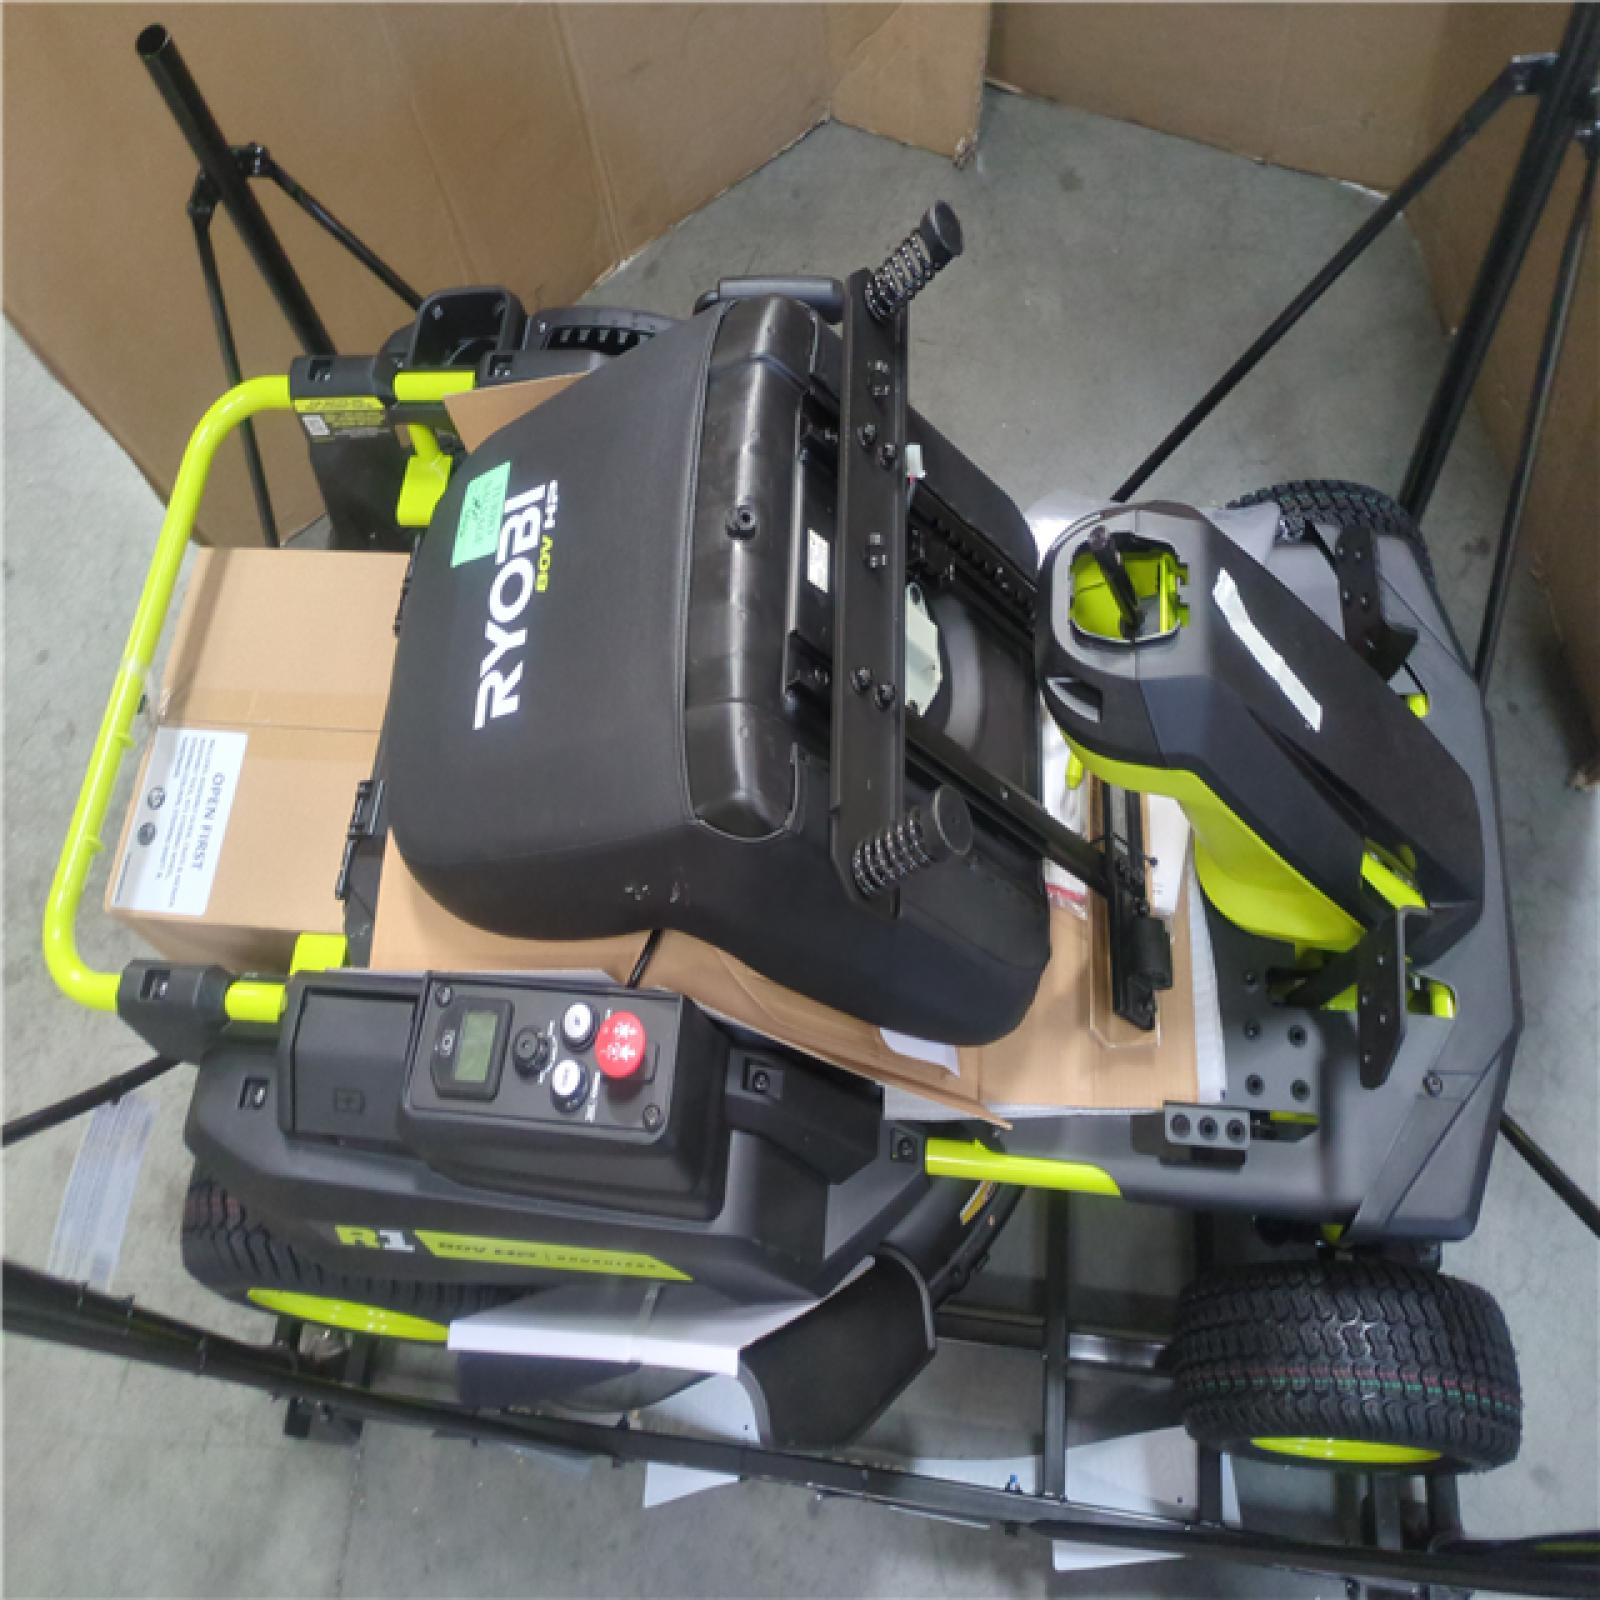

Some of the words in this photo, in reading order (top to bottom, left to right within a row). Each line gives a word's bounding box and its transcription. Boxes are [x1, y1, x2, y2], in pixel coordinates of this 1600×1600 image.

[472, 484, 546, 730] RYOBI
[203, 771, 225, 820] OPEN
[192, 824, 213, 871] FIRST
[335, 1225, 416, 1252] R1
